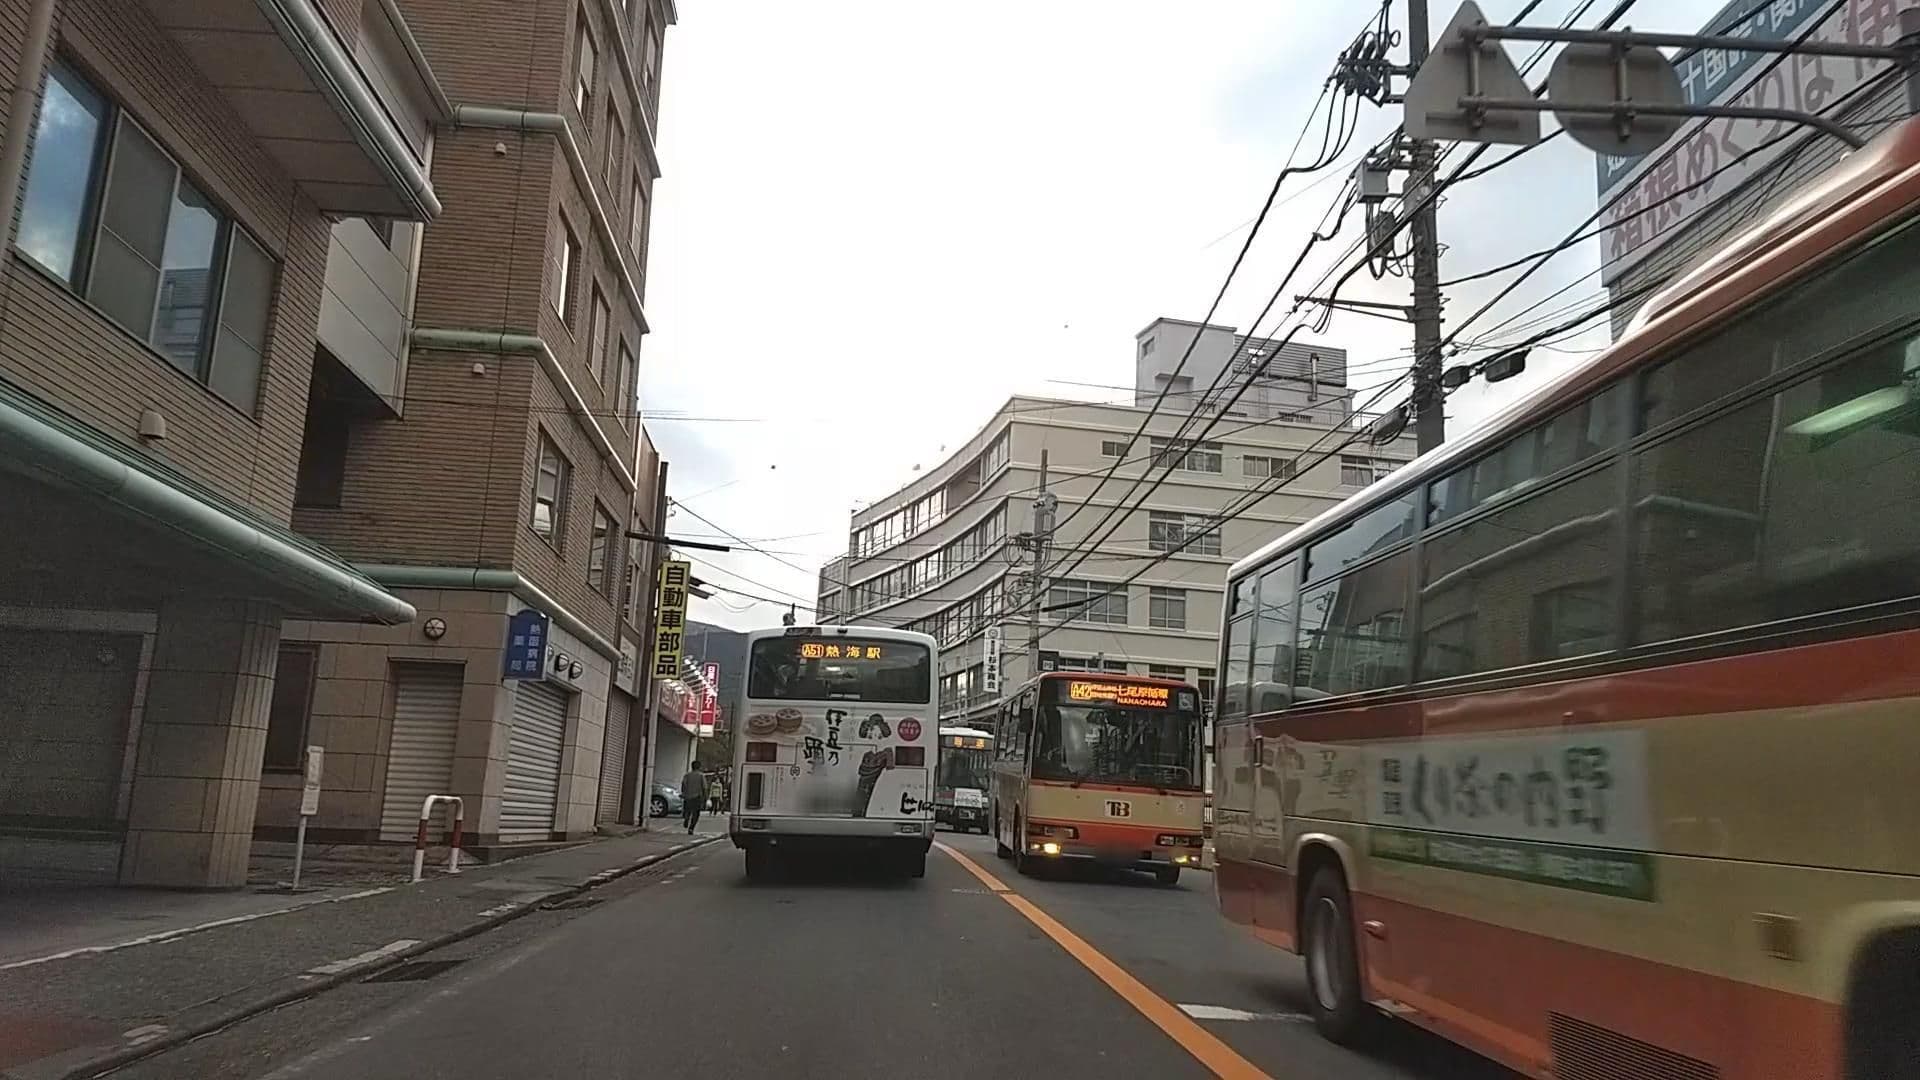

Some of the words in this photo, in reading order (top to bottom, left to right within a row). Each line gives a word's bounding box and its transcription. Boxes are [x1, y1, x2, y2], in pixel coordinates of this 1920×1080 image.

[655, 565, 685, 676] 自動車部品
[803, 644, 822, 658] A51
[825, 644, 881, 659] 熱海駅
[1117, 697, 1168, 708] NANAOHARA
